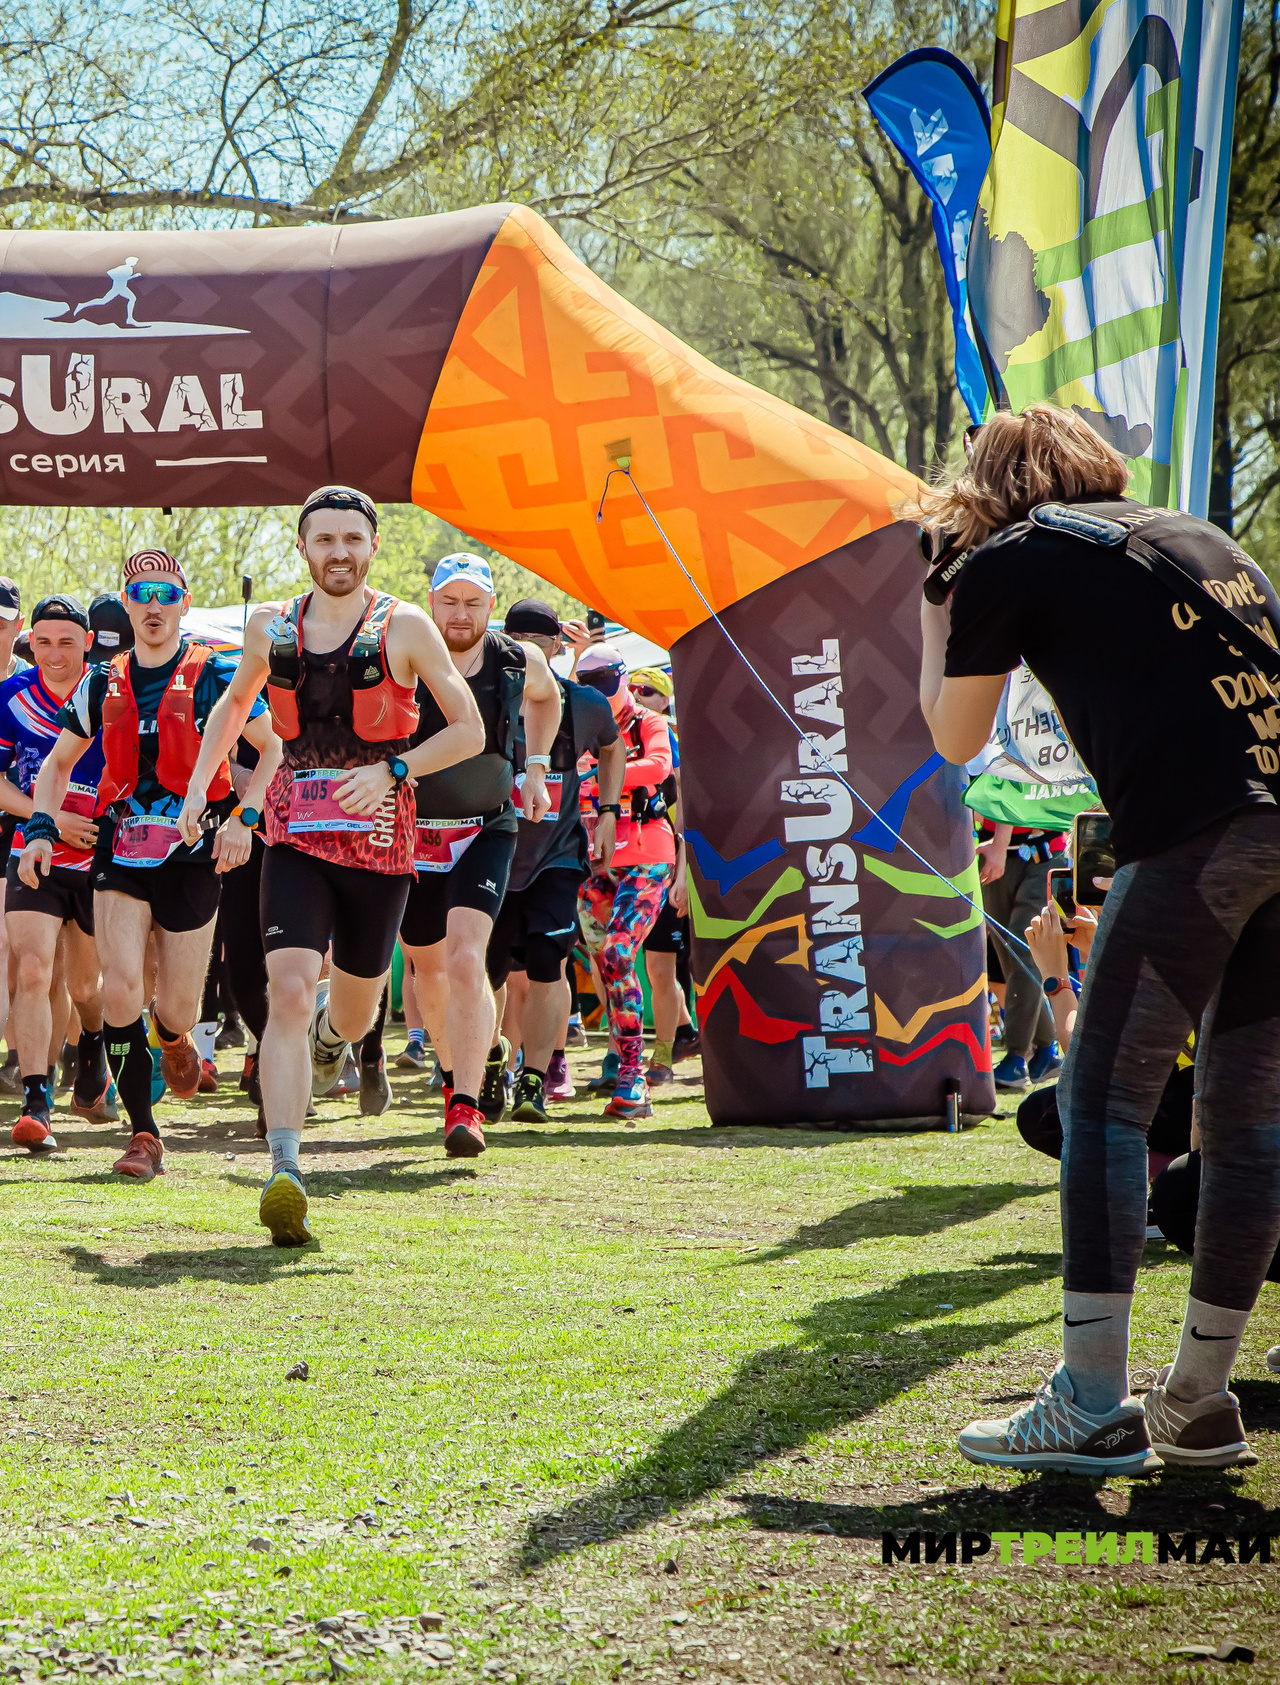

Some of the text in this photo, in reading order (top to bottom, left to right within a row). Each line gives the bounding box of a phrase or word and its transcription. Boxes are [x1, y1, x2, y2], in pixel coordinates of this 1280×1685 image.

[9, 453, 127, 478] серия
[301, 780, 328, 801] 405
[421, 829, 442, 847] 456
